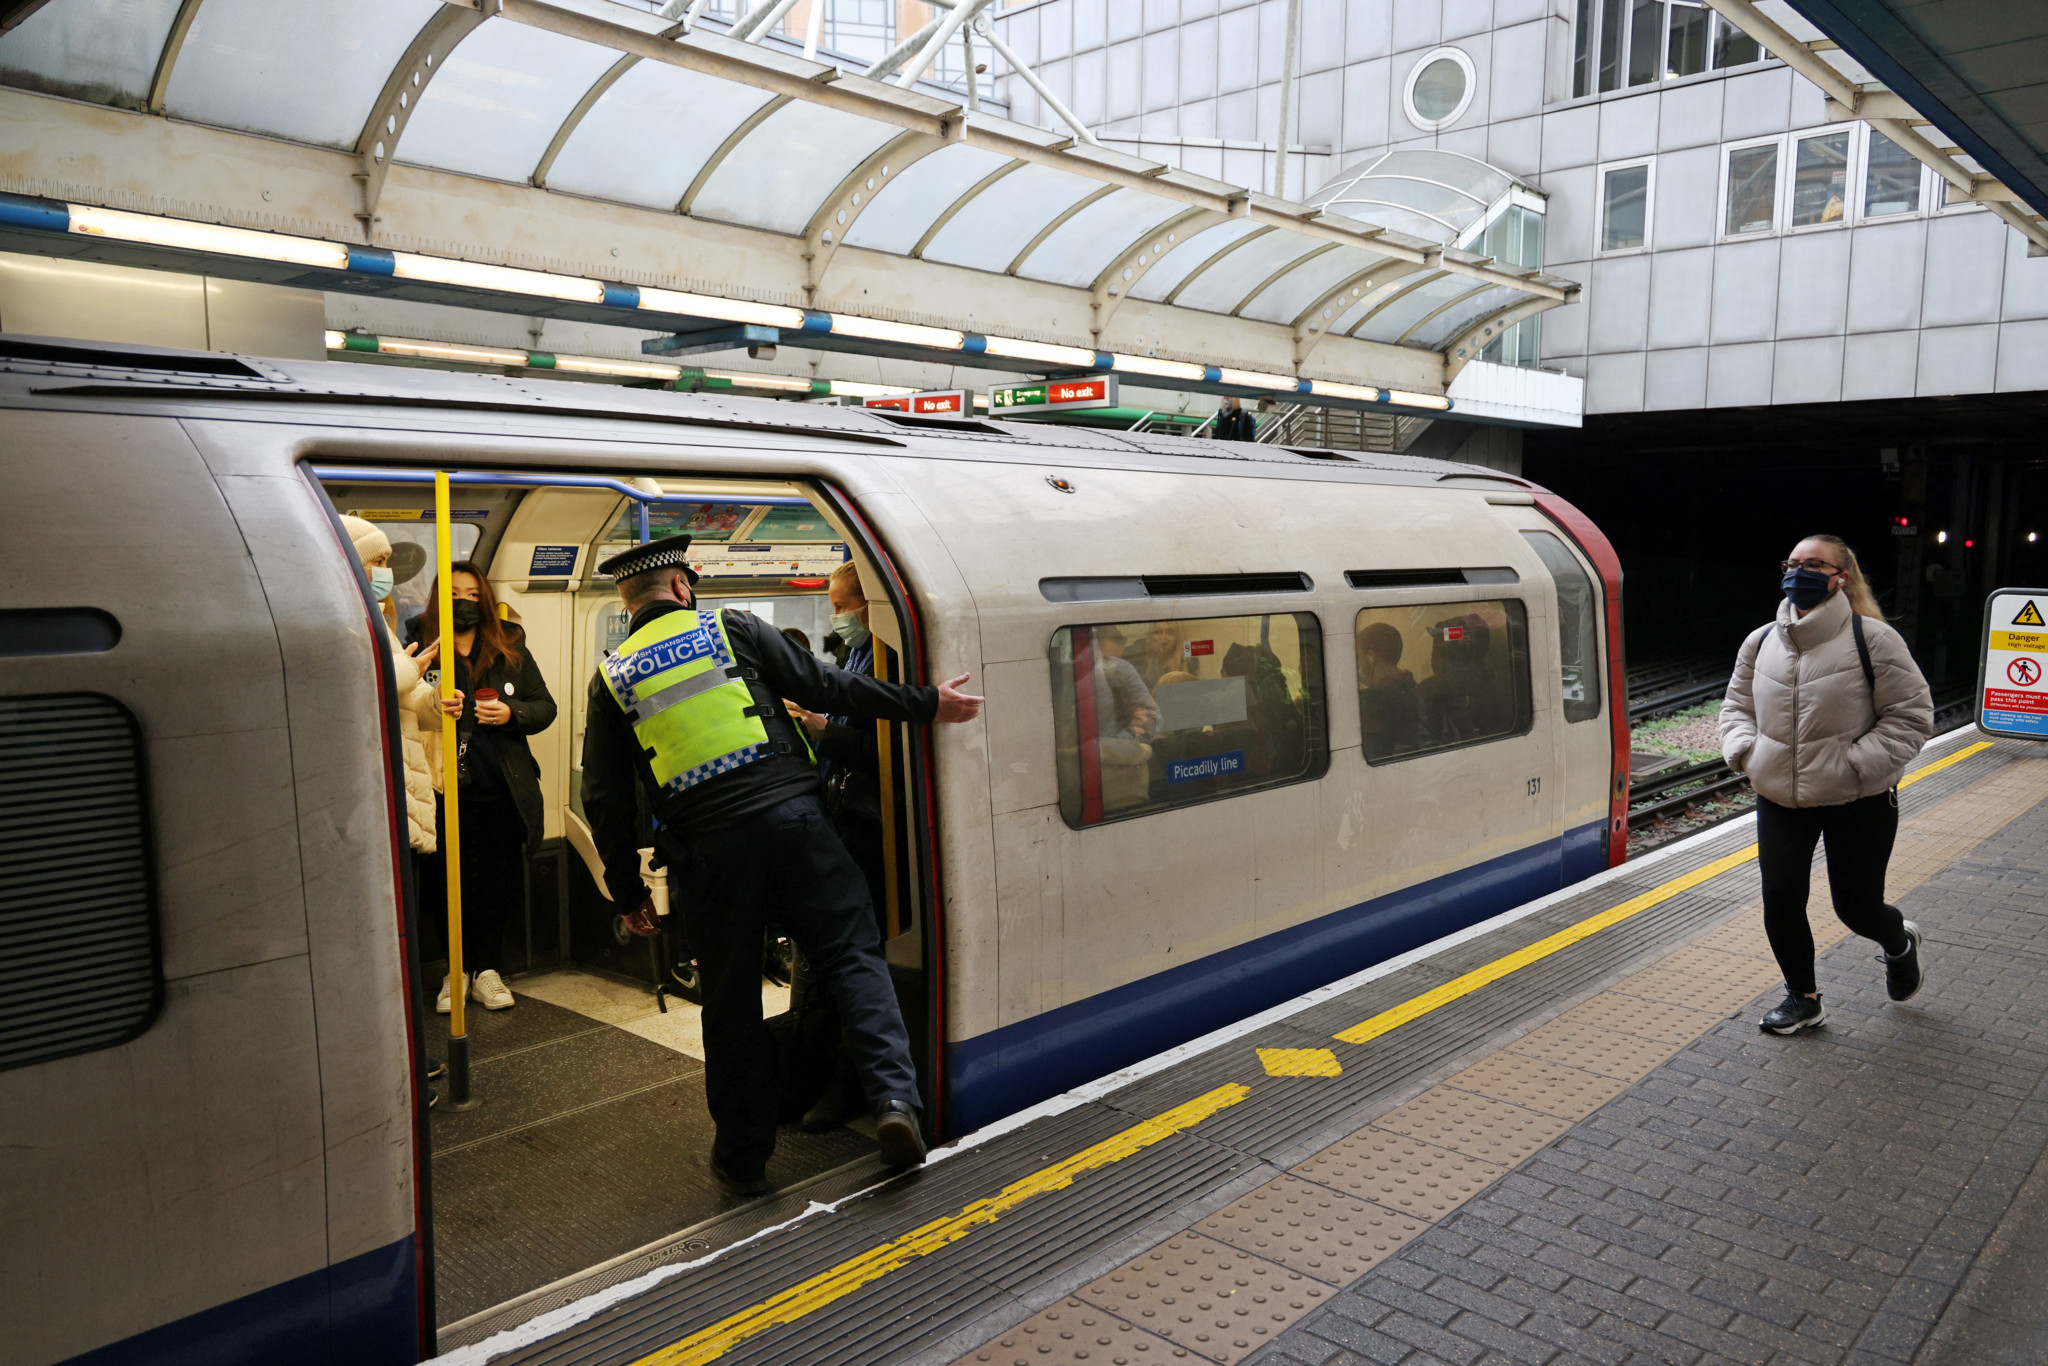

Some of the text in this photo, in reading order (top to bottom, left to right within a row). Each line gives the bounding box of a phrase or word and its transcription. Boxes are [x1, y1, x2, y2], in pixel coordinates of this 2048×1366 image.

[1061, 386, 1094, 399] No exit
[923, 399, 952, 410] No exit
[653, 630, 703, 652] TRANSPORT
[2008, 633, 2040, 643] Danger
[623, 638, 710, 685] POLICE
[1991, 691, 2024, 699] Passengers
[1174, 757, 1238, 779] Piccadilly line
[1527, 776, 1541, 796] 131
